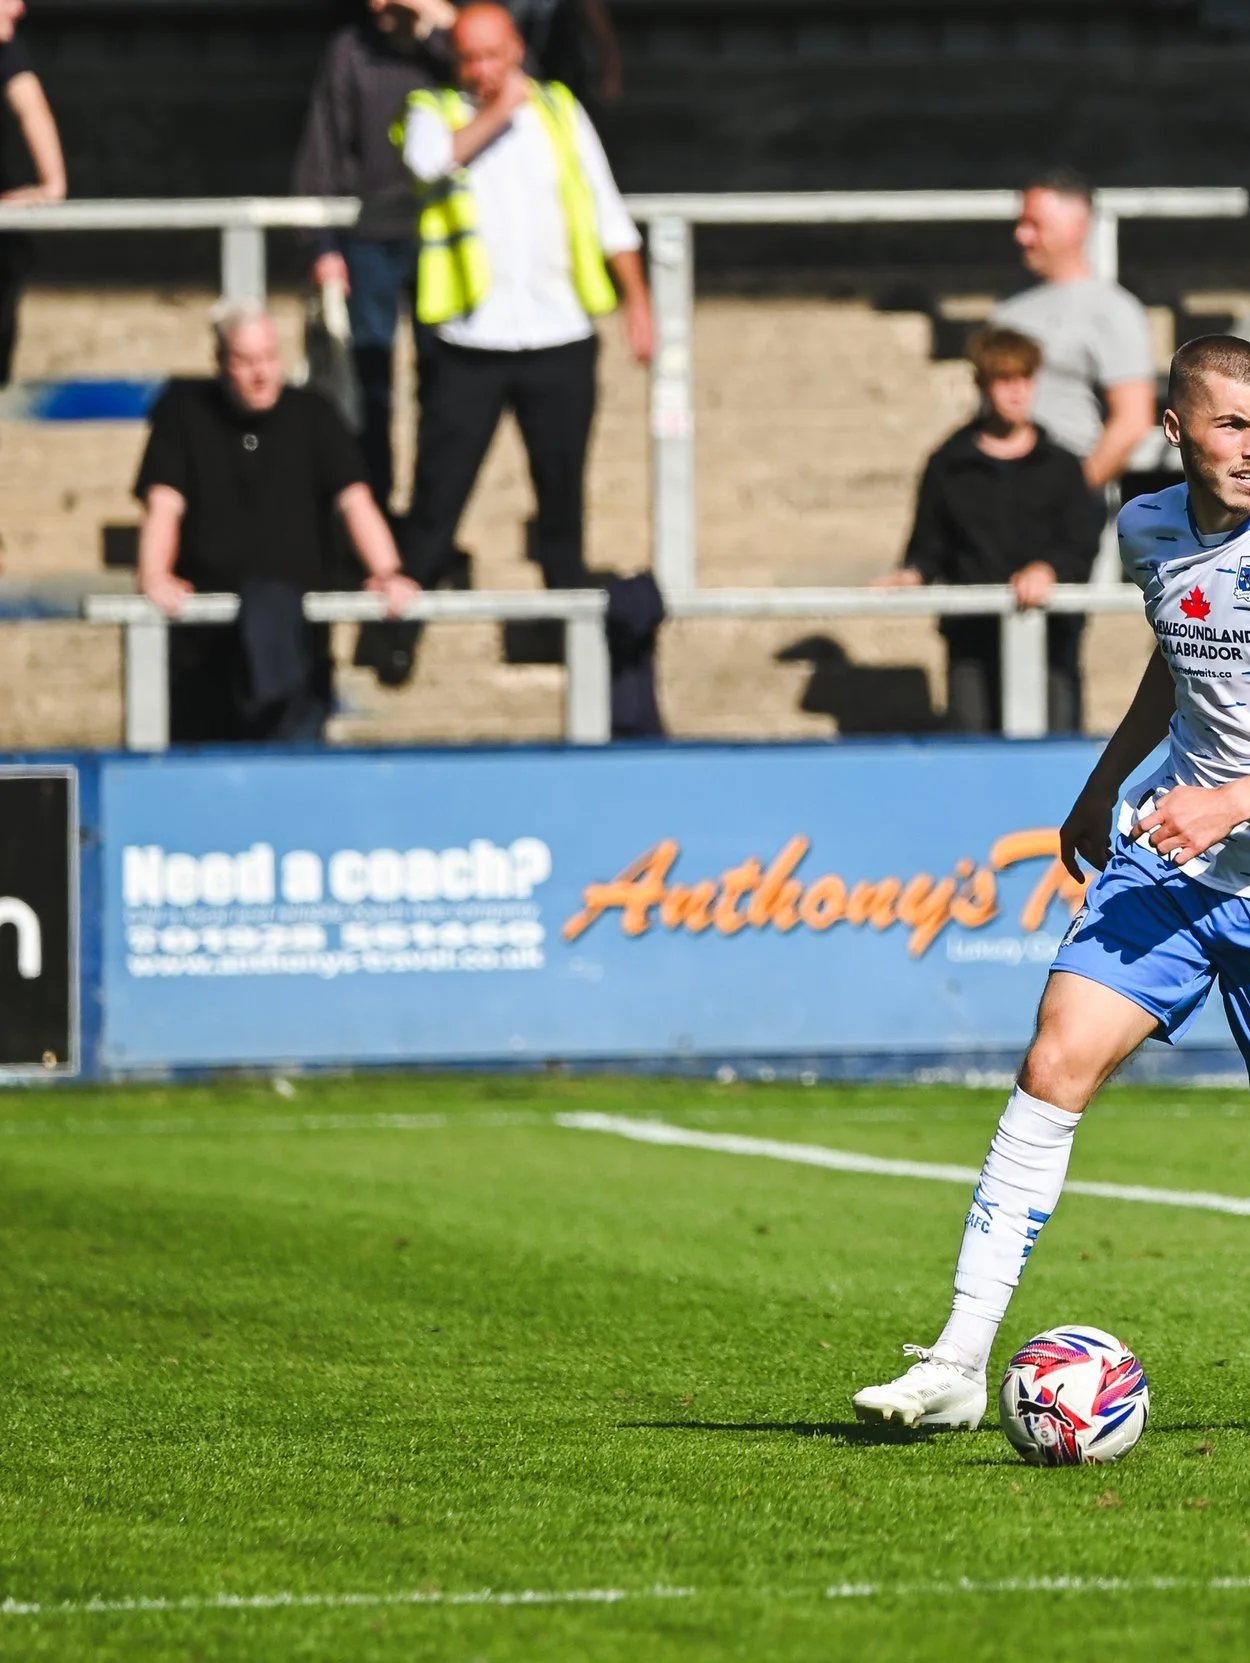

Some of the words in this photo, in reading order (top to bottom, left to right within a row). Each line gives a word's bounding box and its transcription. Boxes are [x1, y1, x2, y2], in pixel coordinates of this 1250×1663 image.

[1170, 640, 1243, 660] LABRADOR
[122, 842, 276, 907] Need
[281, 850, 323, 902] a
[329, 837, 552, 903] coach?
[562, 833, 998, 959] Anthony's
